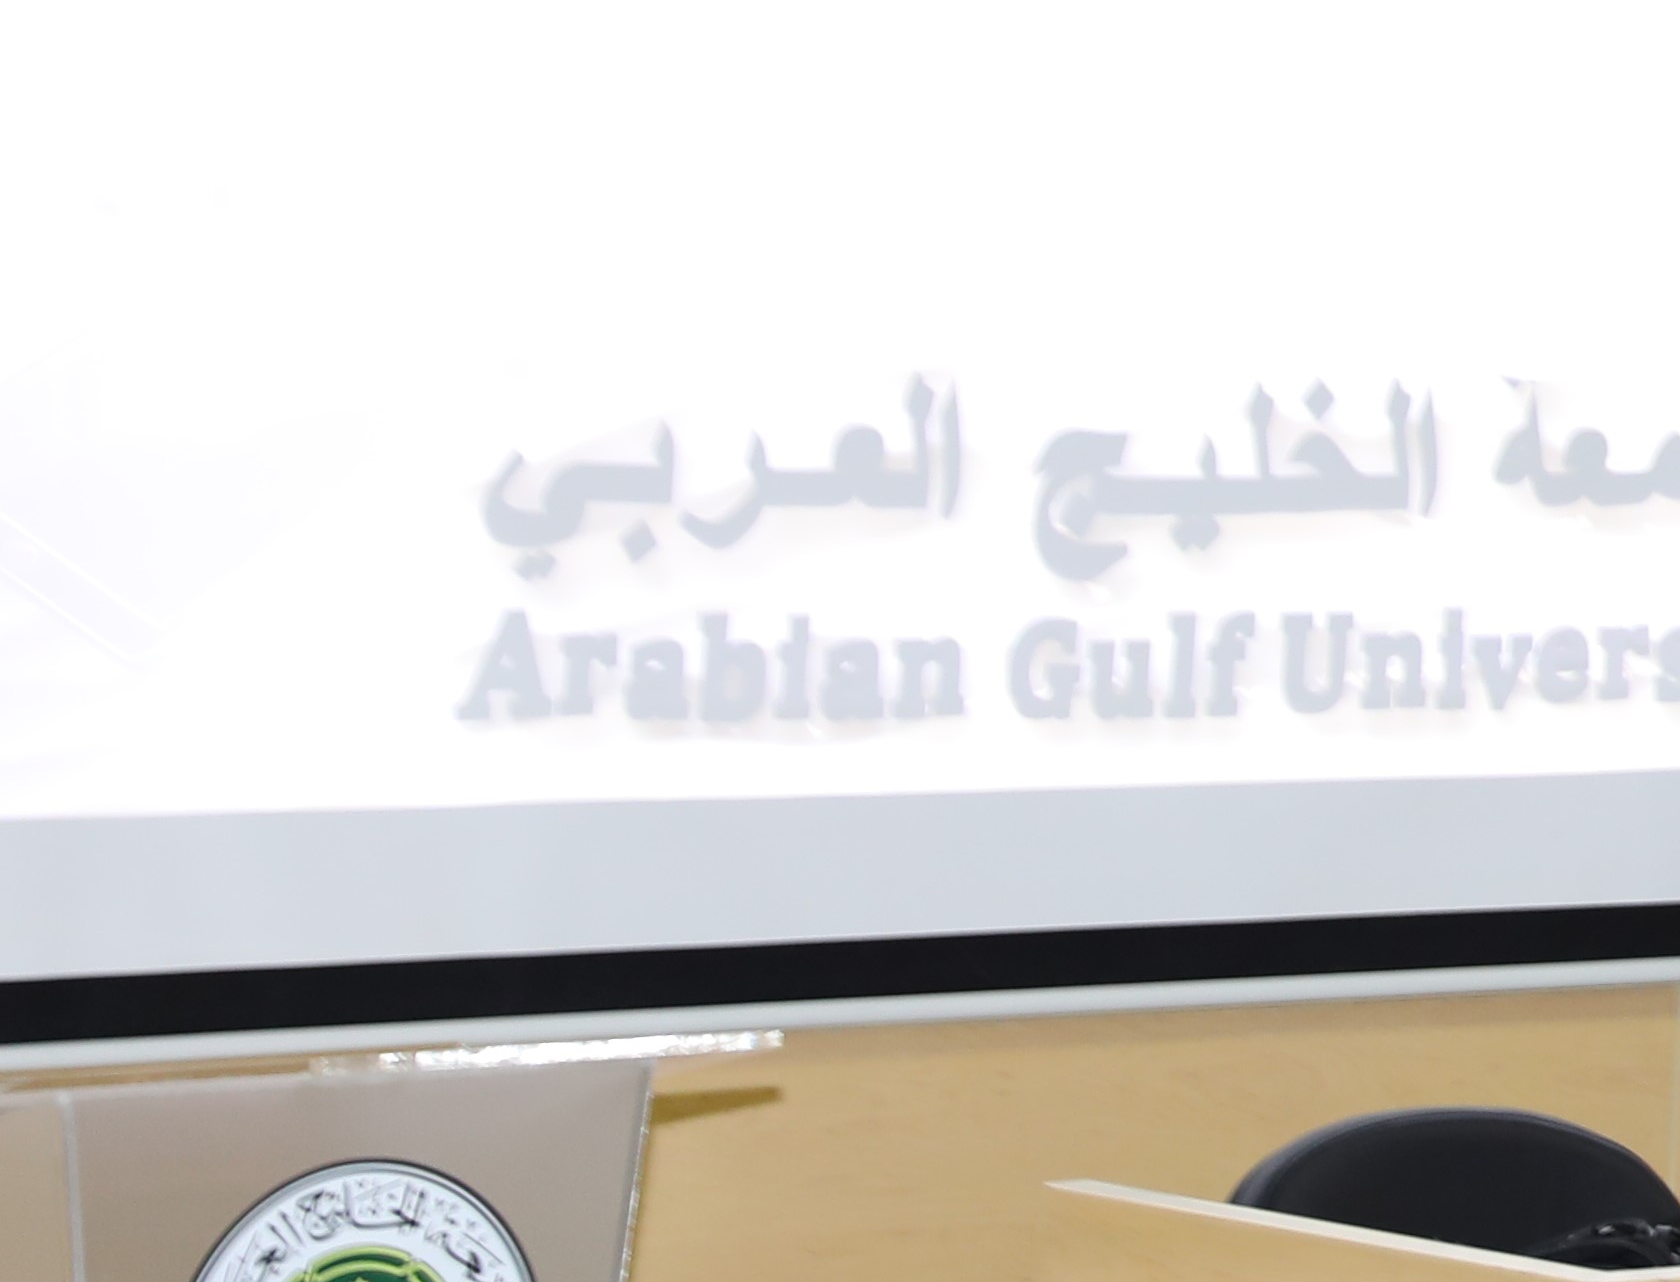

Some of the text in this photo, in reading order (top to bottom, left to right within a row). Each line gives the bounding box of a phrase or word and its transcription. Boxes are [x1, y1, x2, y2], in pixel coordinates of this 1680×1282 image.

[481, 370, 966, 581] العربي
[1032, 376, 1440, 582] الخليج
[454, 608, 970, 726] Arabian
[1006, 611, 1256, 722] Gulf
